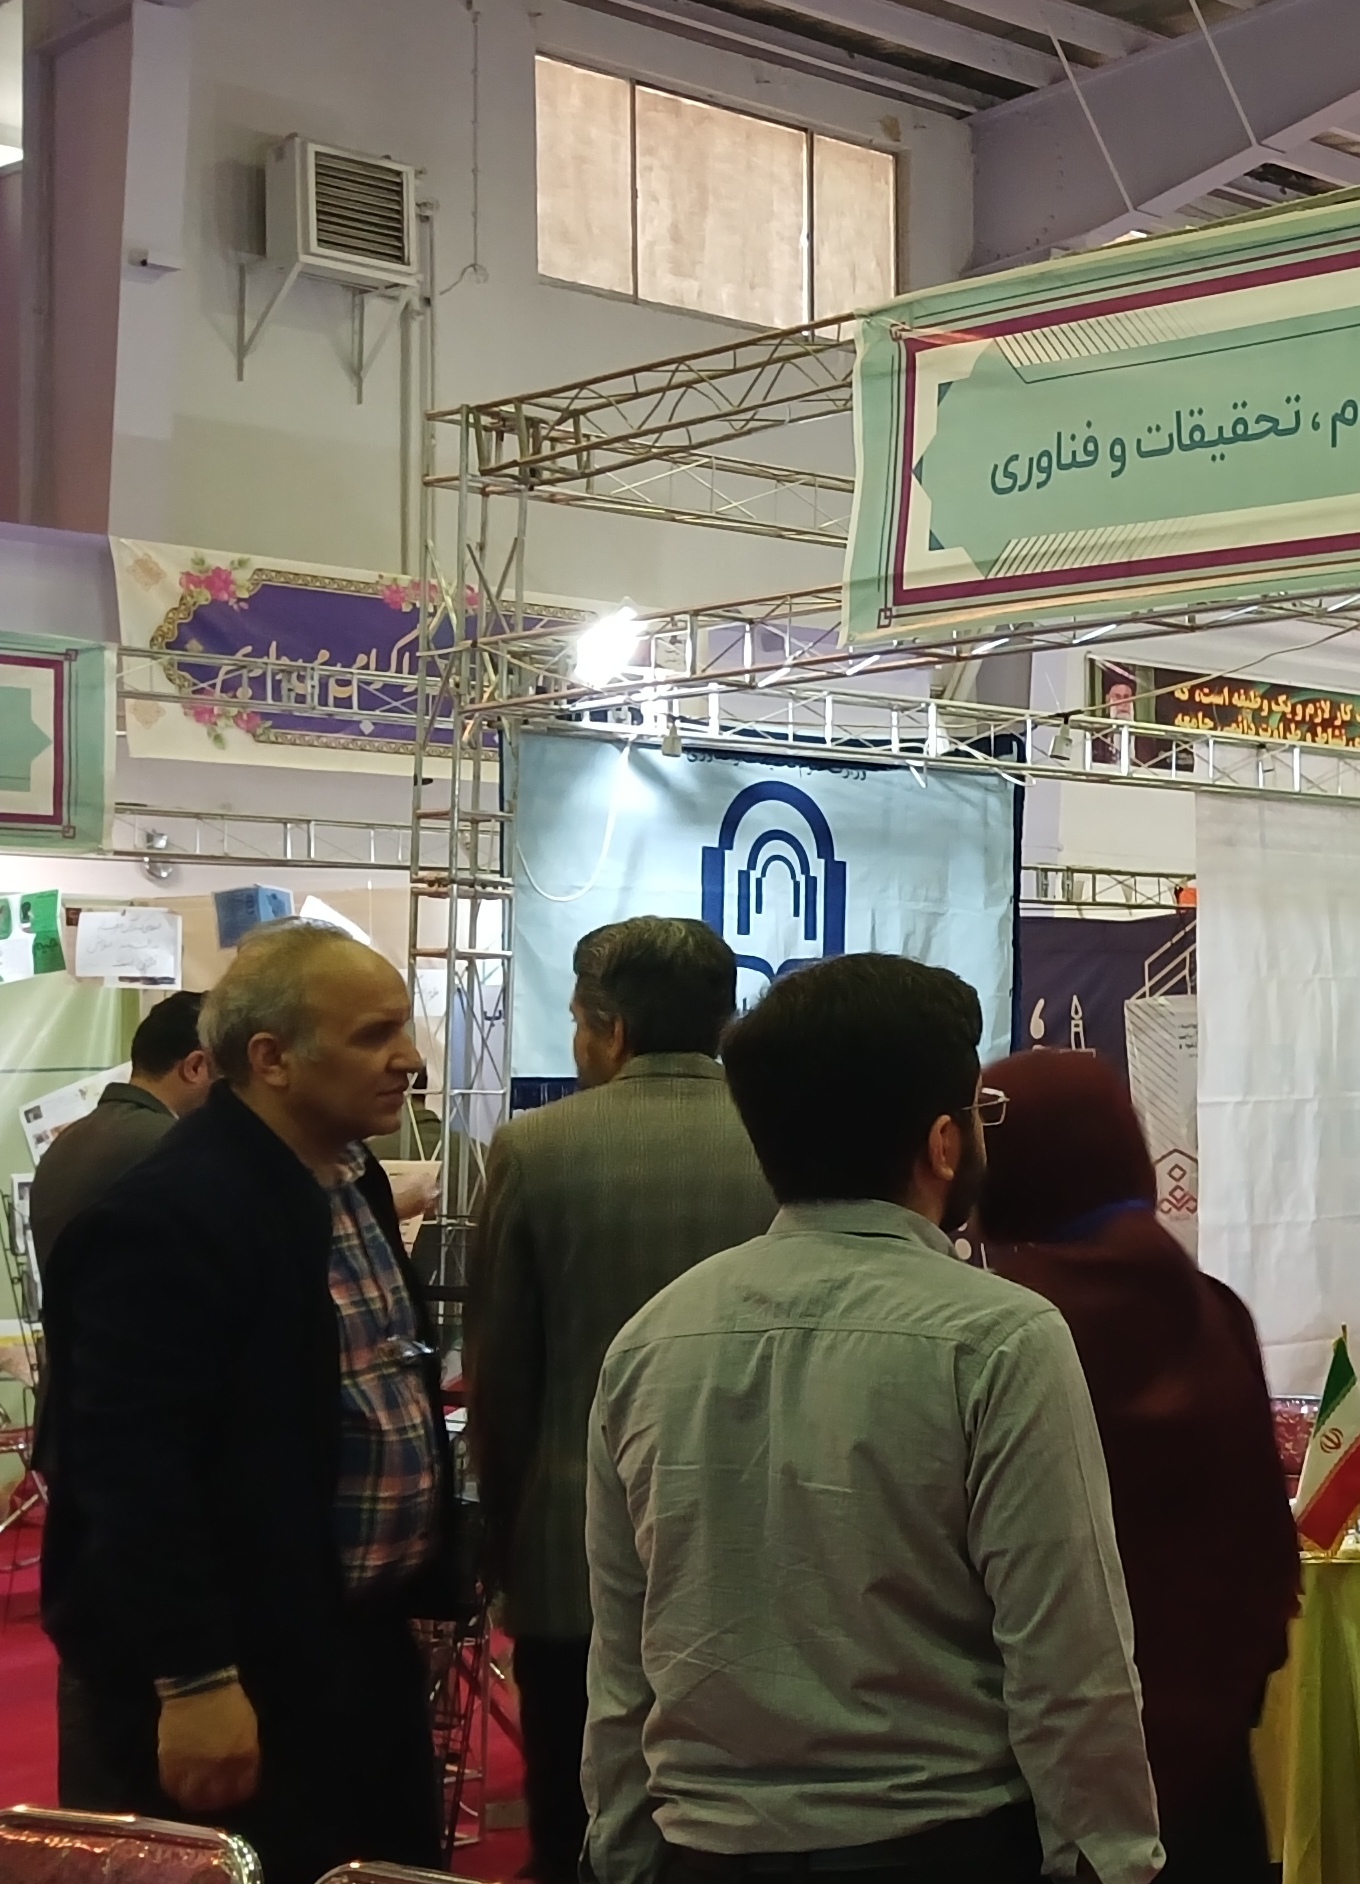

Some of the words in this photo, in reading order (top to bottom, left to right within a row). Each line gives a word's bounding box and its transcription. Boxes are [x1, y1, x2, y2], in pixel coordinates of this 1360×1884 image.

[1136, 393, 1302, 463] تحقیقات
[990, 420, 1100, 496] فناوری
[1109, 435, 1127, 478] و
[1232, 688, 1268, 716] وظیفه
[1305, 700, 1331, 723] لازم
